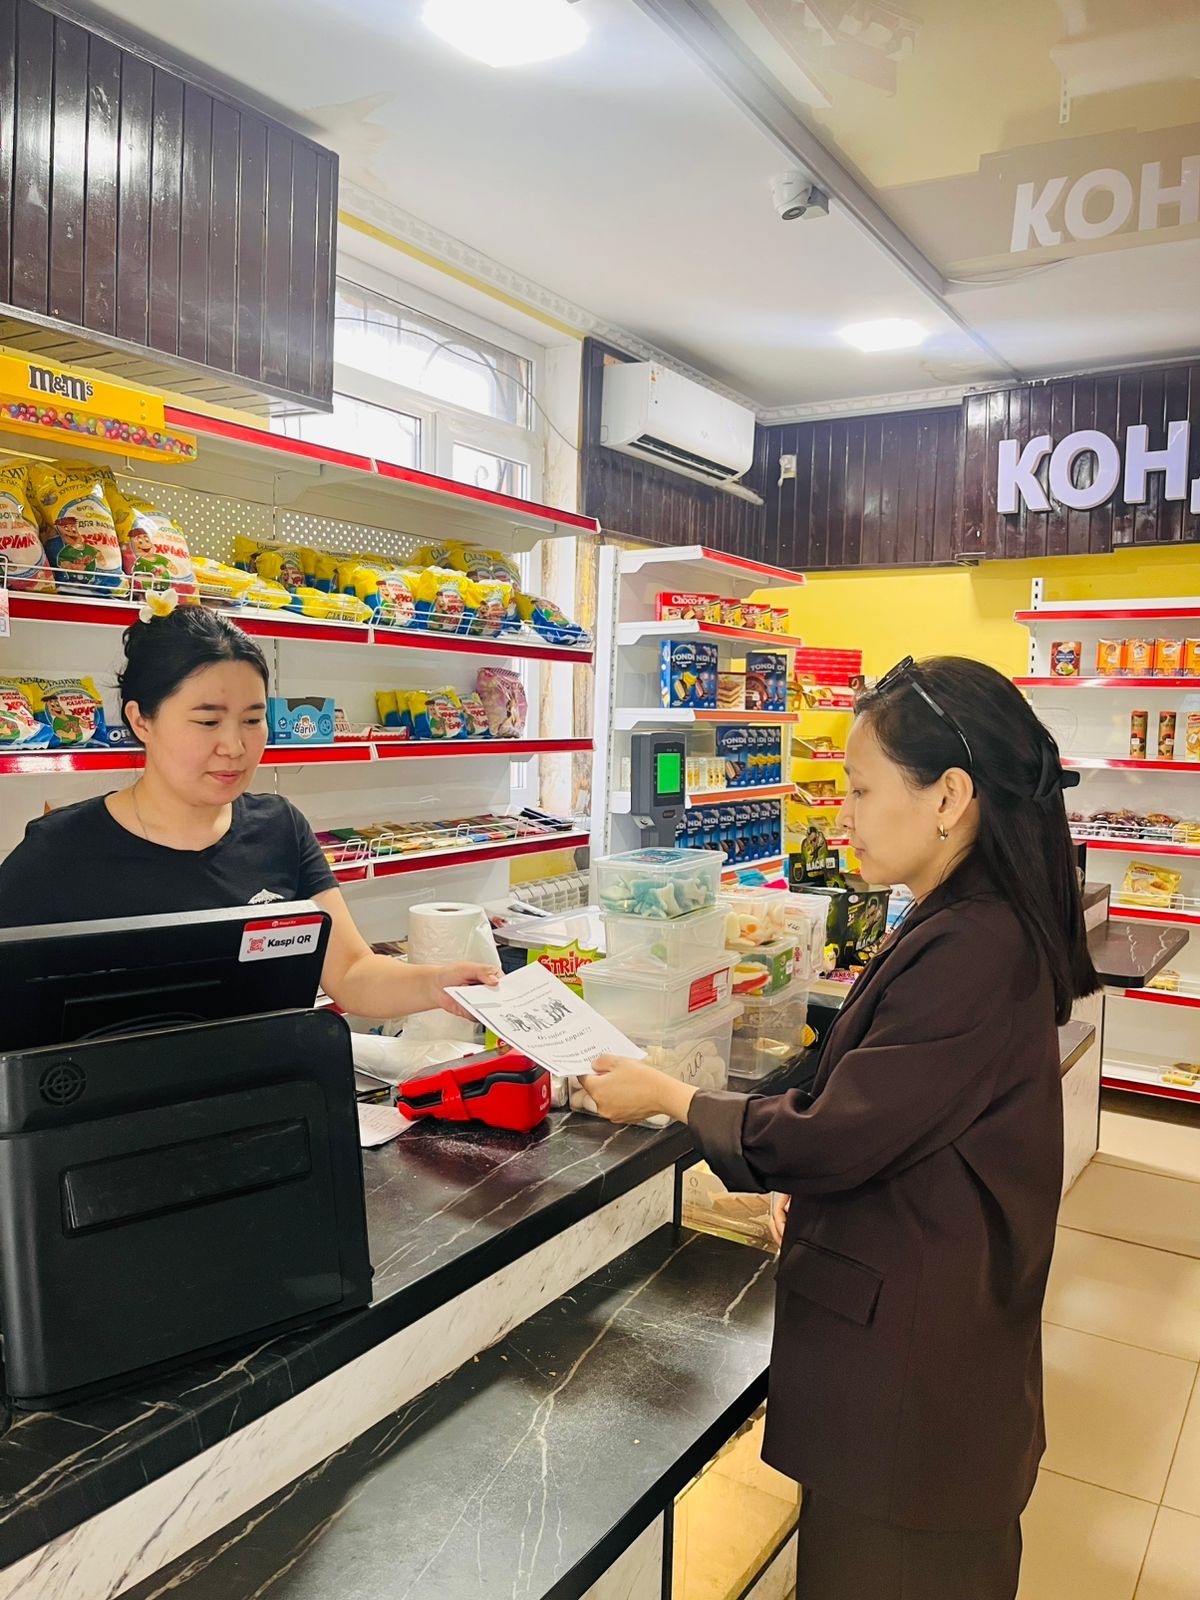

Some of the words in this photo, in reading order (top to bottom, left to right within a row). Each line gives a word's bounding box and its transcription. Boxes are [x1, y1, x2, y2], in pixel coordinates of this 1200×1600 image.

[672, 594, 711, 606] Choco-Pie
[671, 652, 696, 663] TONDI
[750, 662, 775, 671] TONDI
[294, 721, 317, 734] Barni
[721, 737, 747, 746] TONDI
[268, 936, 295, 948] Kaspi
[297, 934, 311, 944] QR
